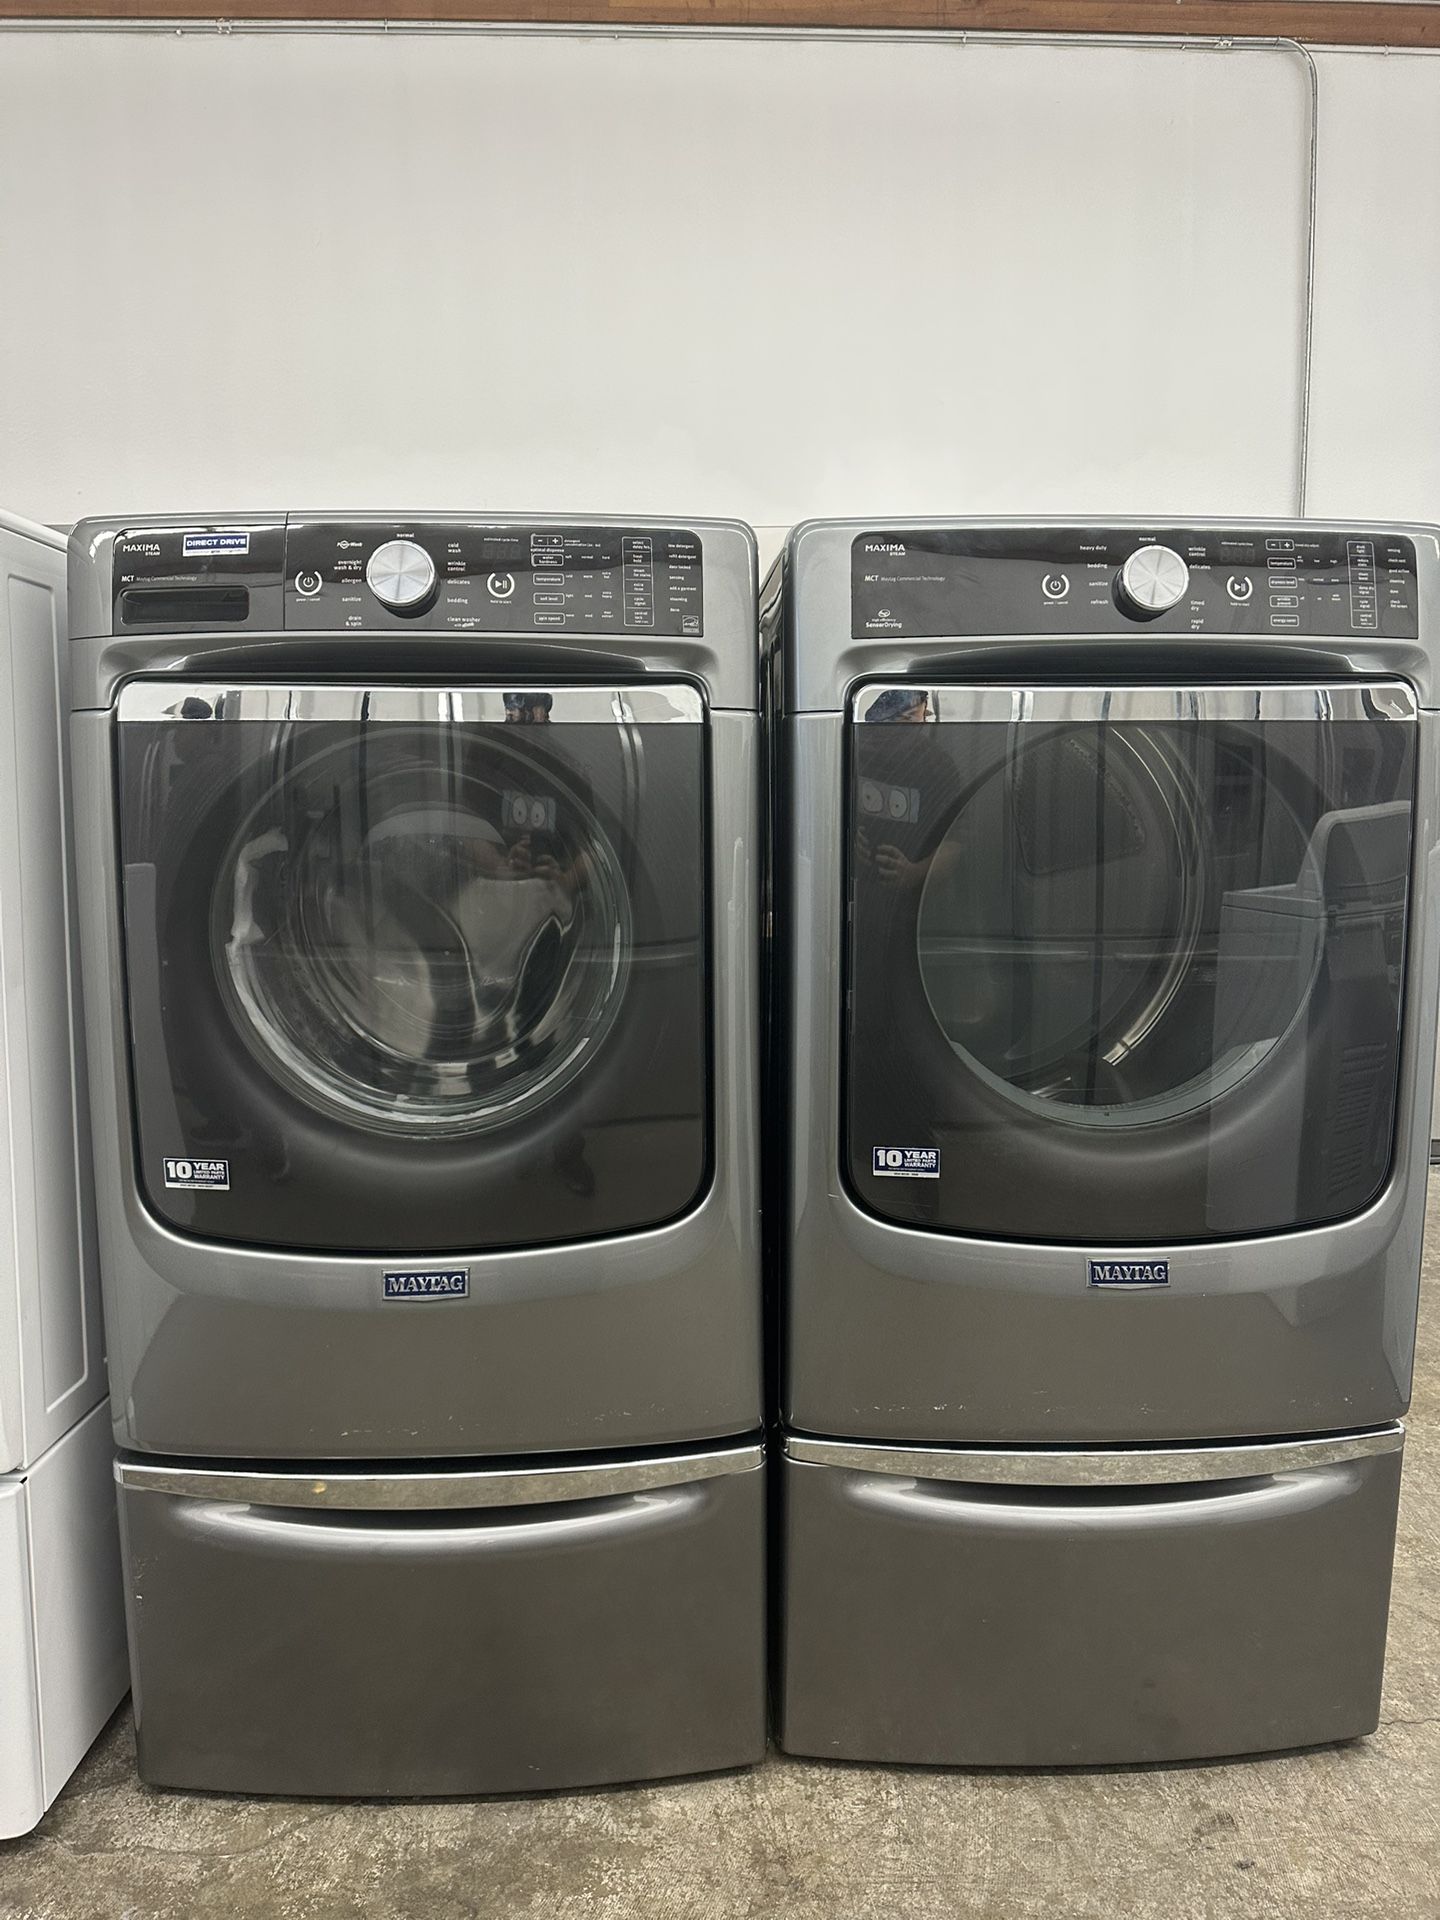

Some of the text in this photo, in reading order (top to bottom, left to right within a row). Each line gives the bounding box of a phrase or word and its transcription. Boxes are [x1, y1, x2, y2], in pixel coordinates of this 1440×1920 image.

[186, 538, 246, 547] DIRECT DRIVE
[122, 543, 161, 552] MAXIMA
[865, 544, 906, 552] MAXIMA
[877, 1150, 903, 1167] 10
[905, 1151, 936, 1159] YEAR
[167, 1161, 192, 1179] 10
[193, 1162, 224, 1170] YEAR
[1093, 1265, 1166, 1280] MAYTAG
[388, 1276, 464, 1293] MAYTAG
